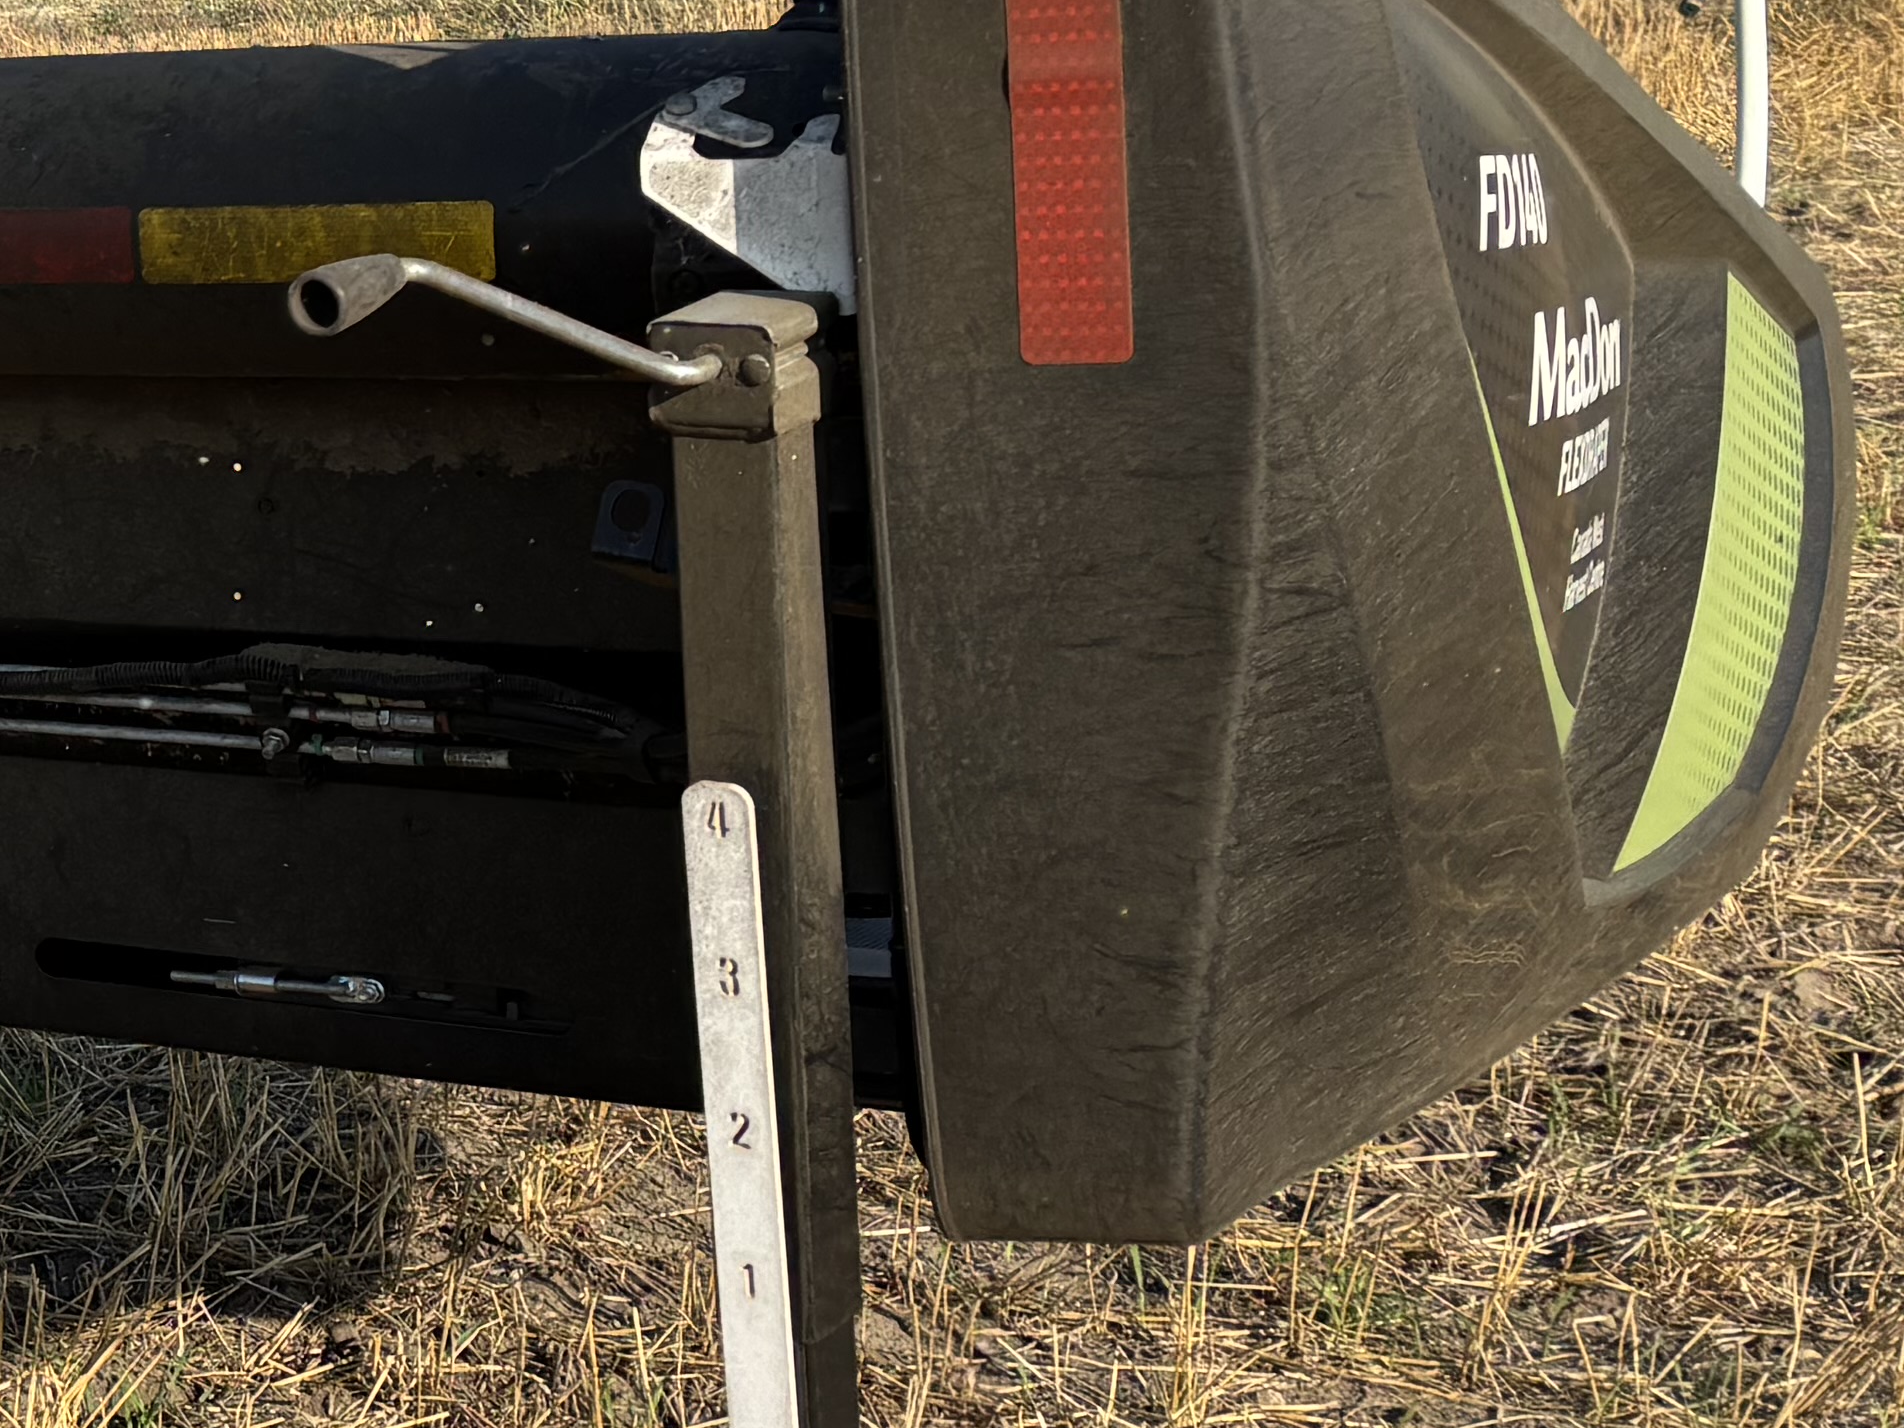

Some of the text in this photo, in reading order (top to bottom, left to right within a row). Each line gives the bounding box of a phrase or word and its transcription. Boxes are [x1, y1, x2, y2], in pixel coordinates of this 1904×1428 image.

[1479, 152, 1548, 252] FD140
[1528, 296, 1621, 427] MacDon
[706, 801, 731, 838] 4
[718, 956, 741, 997] 3
[729, 1111, 753, 1150] 2
[740, 1262, 756, 1299] 1
